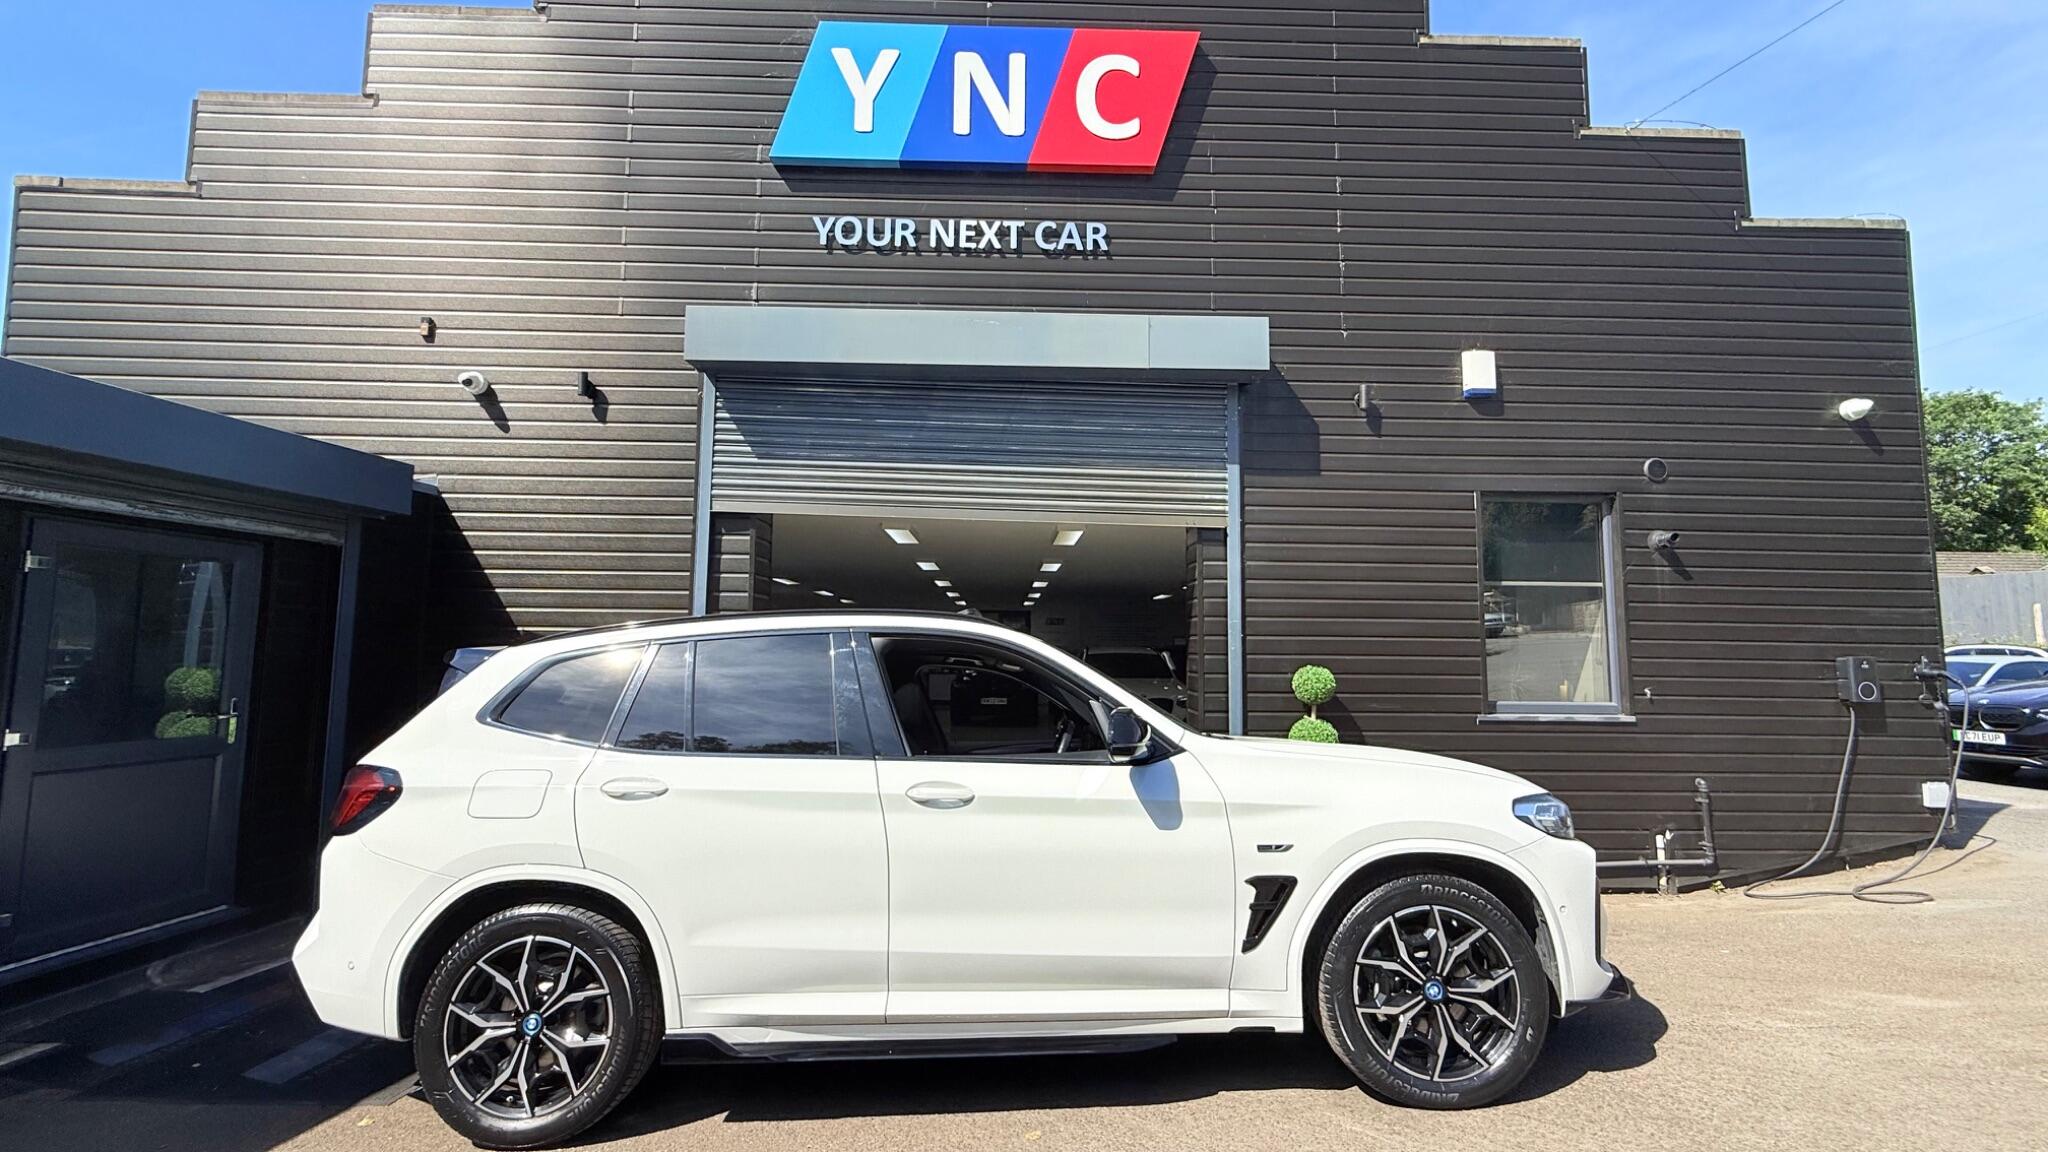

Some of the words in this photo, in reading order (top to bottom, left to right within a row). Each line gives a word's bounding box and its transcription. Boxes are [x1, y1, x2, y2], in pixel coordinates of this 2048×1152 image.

[831, 47, 1141, 140] YNC
[812, 216, 917, 248] YOUR
[929, 219, 1025, 250] NEXT
[1034, 221, 1109, 251] CAR
